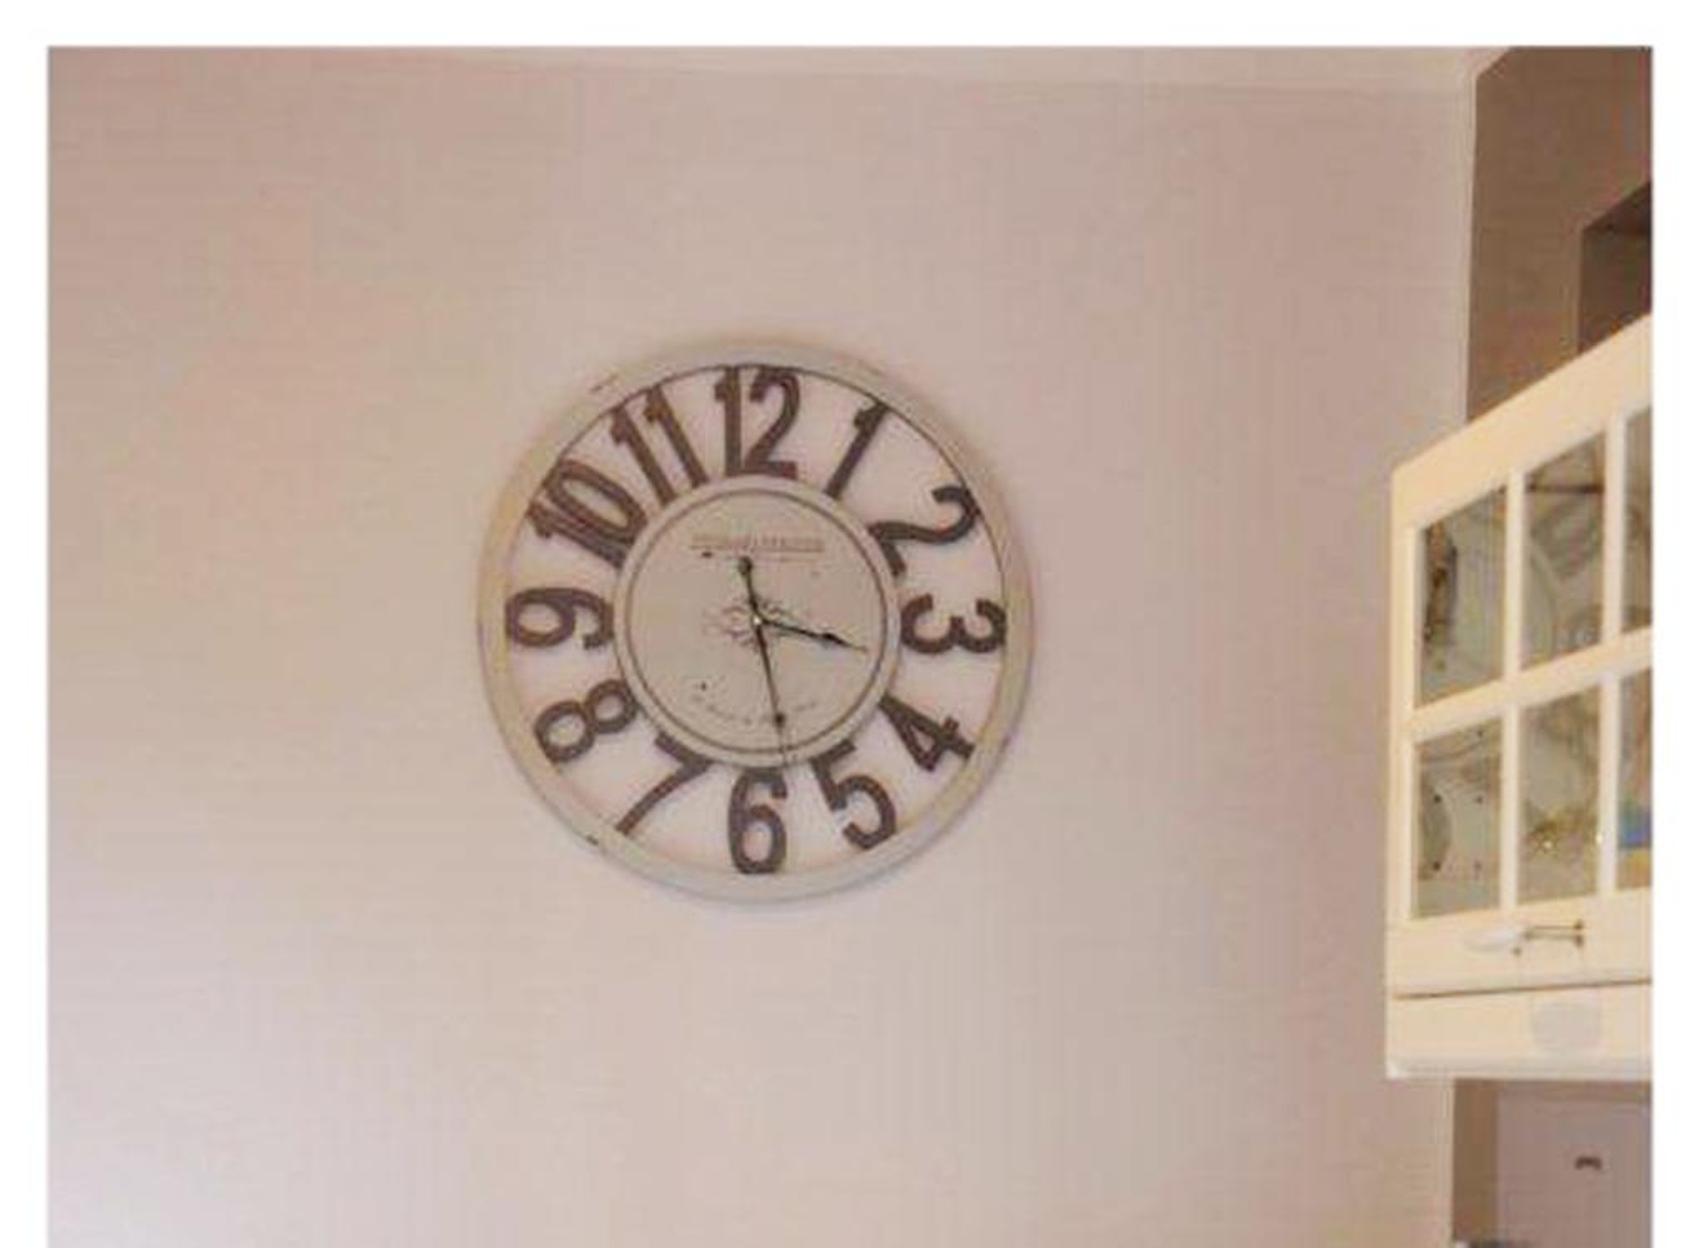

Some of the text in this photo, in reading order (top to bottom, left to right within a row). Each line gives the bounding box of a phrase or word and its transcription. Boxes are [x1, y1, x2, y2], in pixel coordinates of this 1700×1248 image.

[609, 386, 707, 505] 11
[714, 364, 799, 478] 12
[825, 400, 890, 499] 1
[526, 459, 648, 568] 10
[867, 485, 981, 576] 2
[504, 586, 615, 650] 9
[901, 593, 1006, 655] 3
[534, 679, 640, 764] 8
[877, 694, 975, 772] 4
[616, 731, 713, 836] 7
[728, 768, 787, 874] 6
[811, 737, 896, 850] 5
